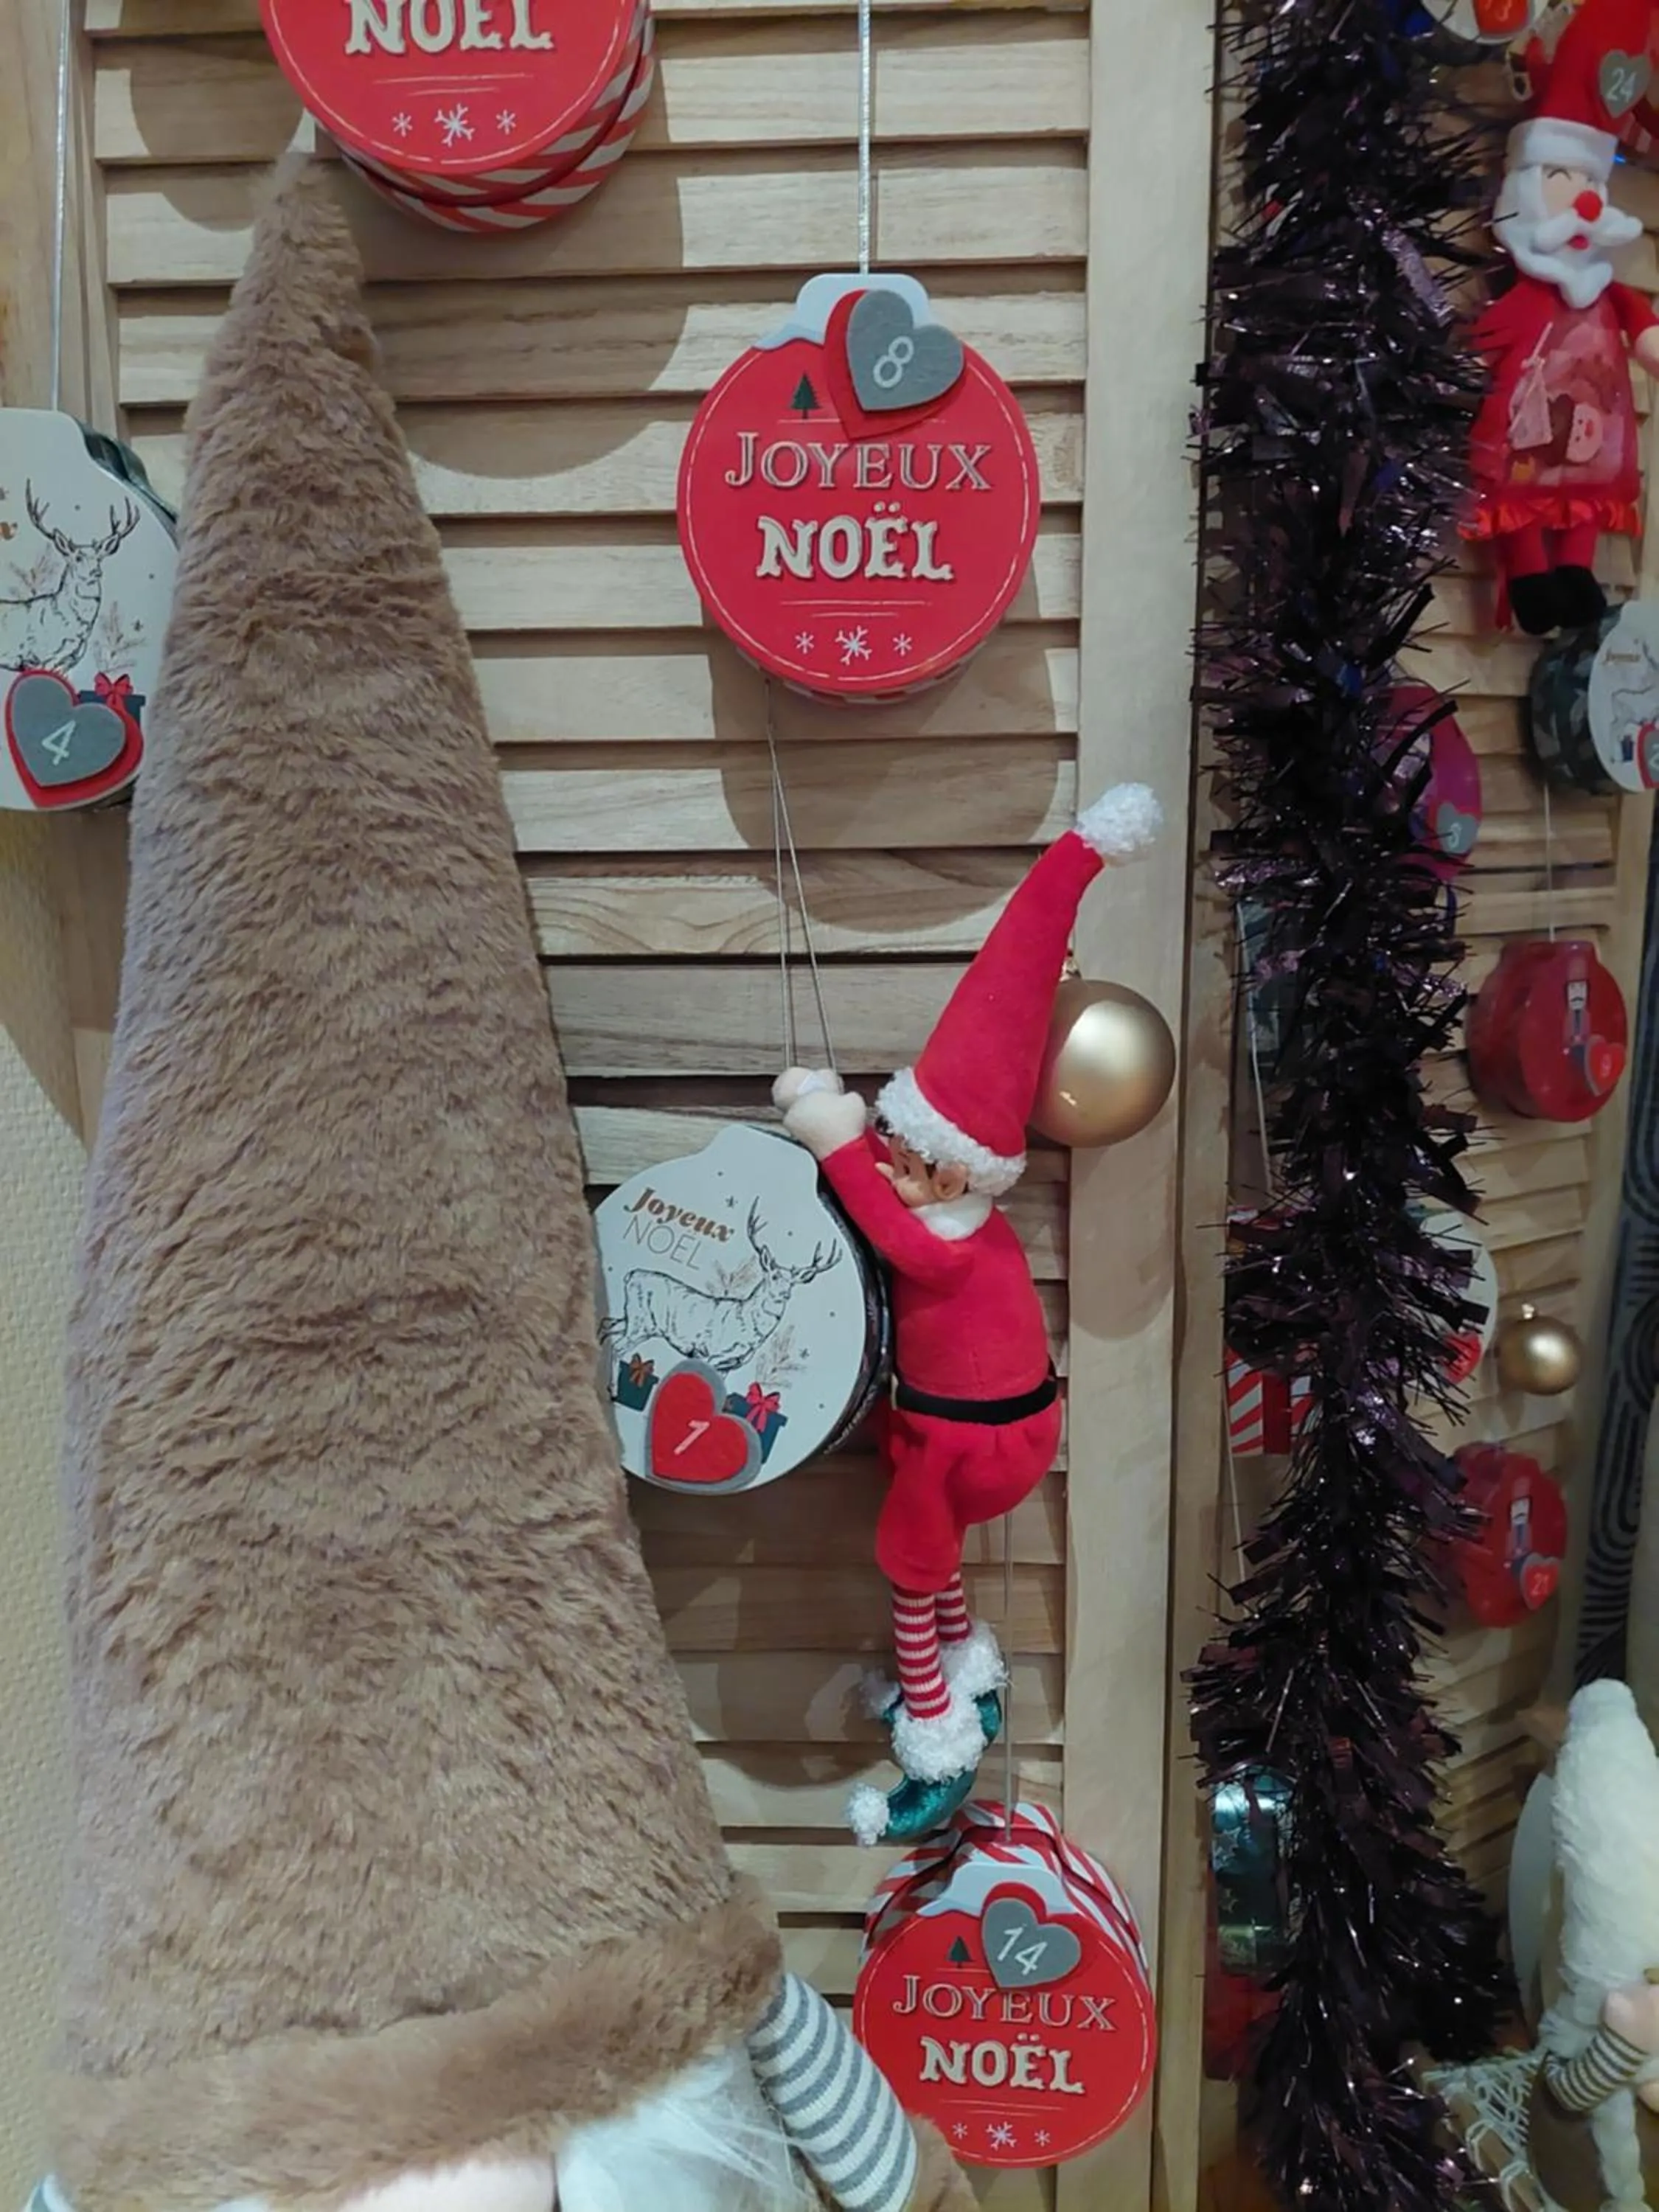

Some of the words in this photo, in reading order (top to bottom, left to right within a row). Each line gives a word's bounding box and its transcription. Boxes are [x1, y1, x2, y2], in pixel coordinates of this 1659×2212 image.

[1605, 66, 1638, 104] 24
[873, 335, 914, 389] 8
[724, 431, 992, 491] JOYEUX
[756, 502, 955, 582] NOËL
[41, 720, 77, 765] 4
[623, 1186, 735, 1242] Joyeux
[674, 1419, 710, 1455] 1
[996, 1926, 1048, 1976] 14
[893, 1975, 1117, 2031] JOYEUX
[919, 2033, 1085, 2095] NOËL
